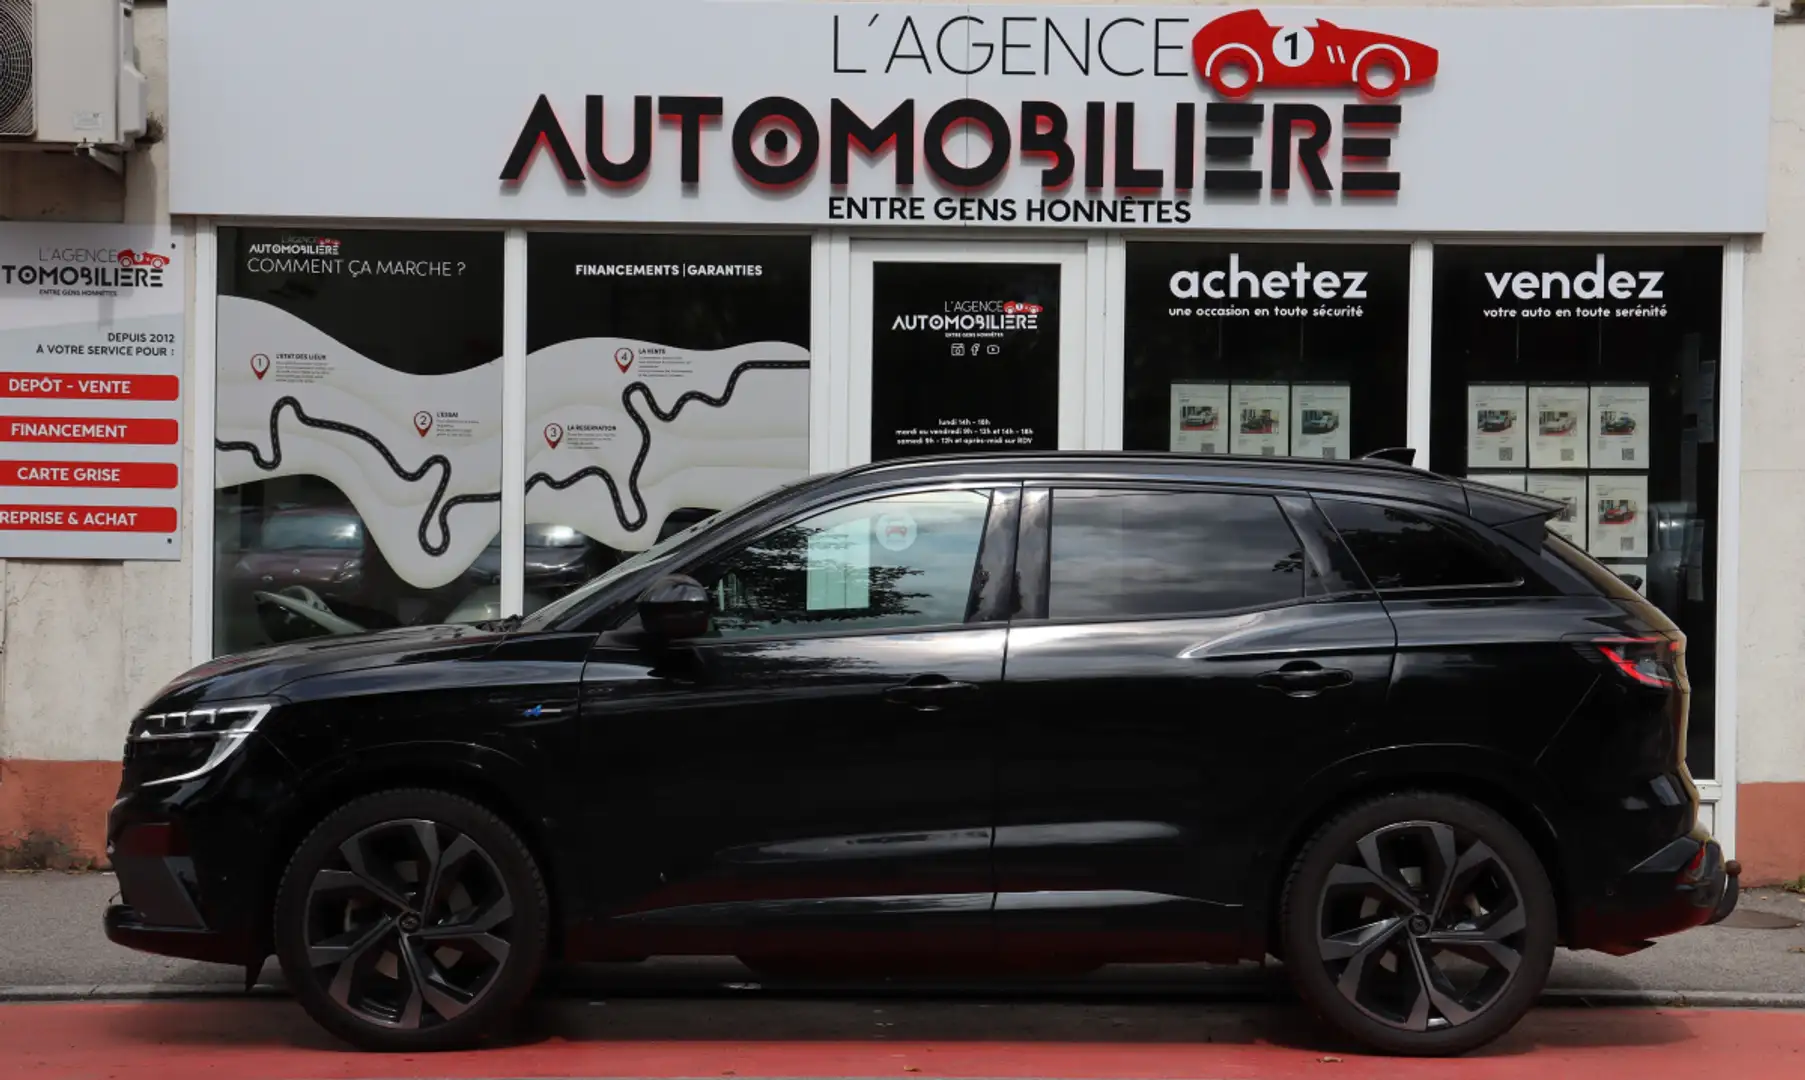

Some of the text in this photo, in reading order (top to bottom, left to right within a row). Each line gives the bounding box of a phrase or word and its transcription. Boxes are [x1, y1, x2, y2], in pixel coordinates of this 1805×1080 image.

[833, 13, 1189, 76] L'AGENCE
[1283, 31, 1299, 61] 1
[499, 93, 1402, 192] AUTOMOBILIERE
[829, 195, 1192, 223] ENTRE GENS HONNÊTES
[38, 248, 118, 263] L'AGENCE
[247, 257, 466, 278] COMMENT ÇA MARCHE ?
[575, 264, 680, 276] FINANCEMENTS
[687, 264, 763, 276] GARANTIES
[1169, 253, 1368, 299] achetez
[1484, 253, 1665, 299] vendez
[944, 300, 1004, 313] L'AGENCE
[1168, 304, 1364, 318] une occasion en toute sécurité
[1483, 304, 1668, 318] votre auto en toute serénité
[107, 332, 175, 344] DEPUIS 2012
[47, 344, 85, 355] VOTRE
[87, 345, 133, 356] SERVICE
[135, 346, 167, 357] POUR
[8, 376, 63, 393] DEPÔT
[78, 379, 131, 394] VENTE
[419, 415, 427, 426] 2
[11, 422, 128, 438] FINANCEMENT
[550, 426, 558, 438] 3
[17, 466, 121, 482] CARTE GRISE
[0, 510, 138, 526] REPRISE & ACHAT
